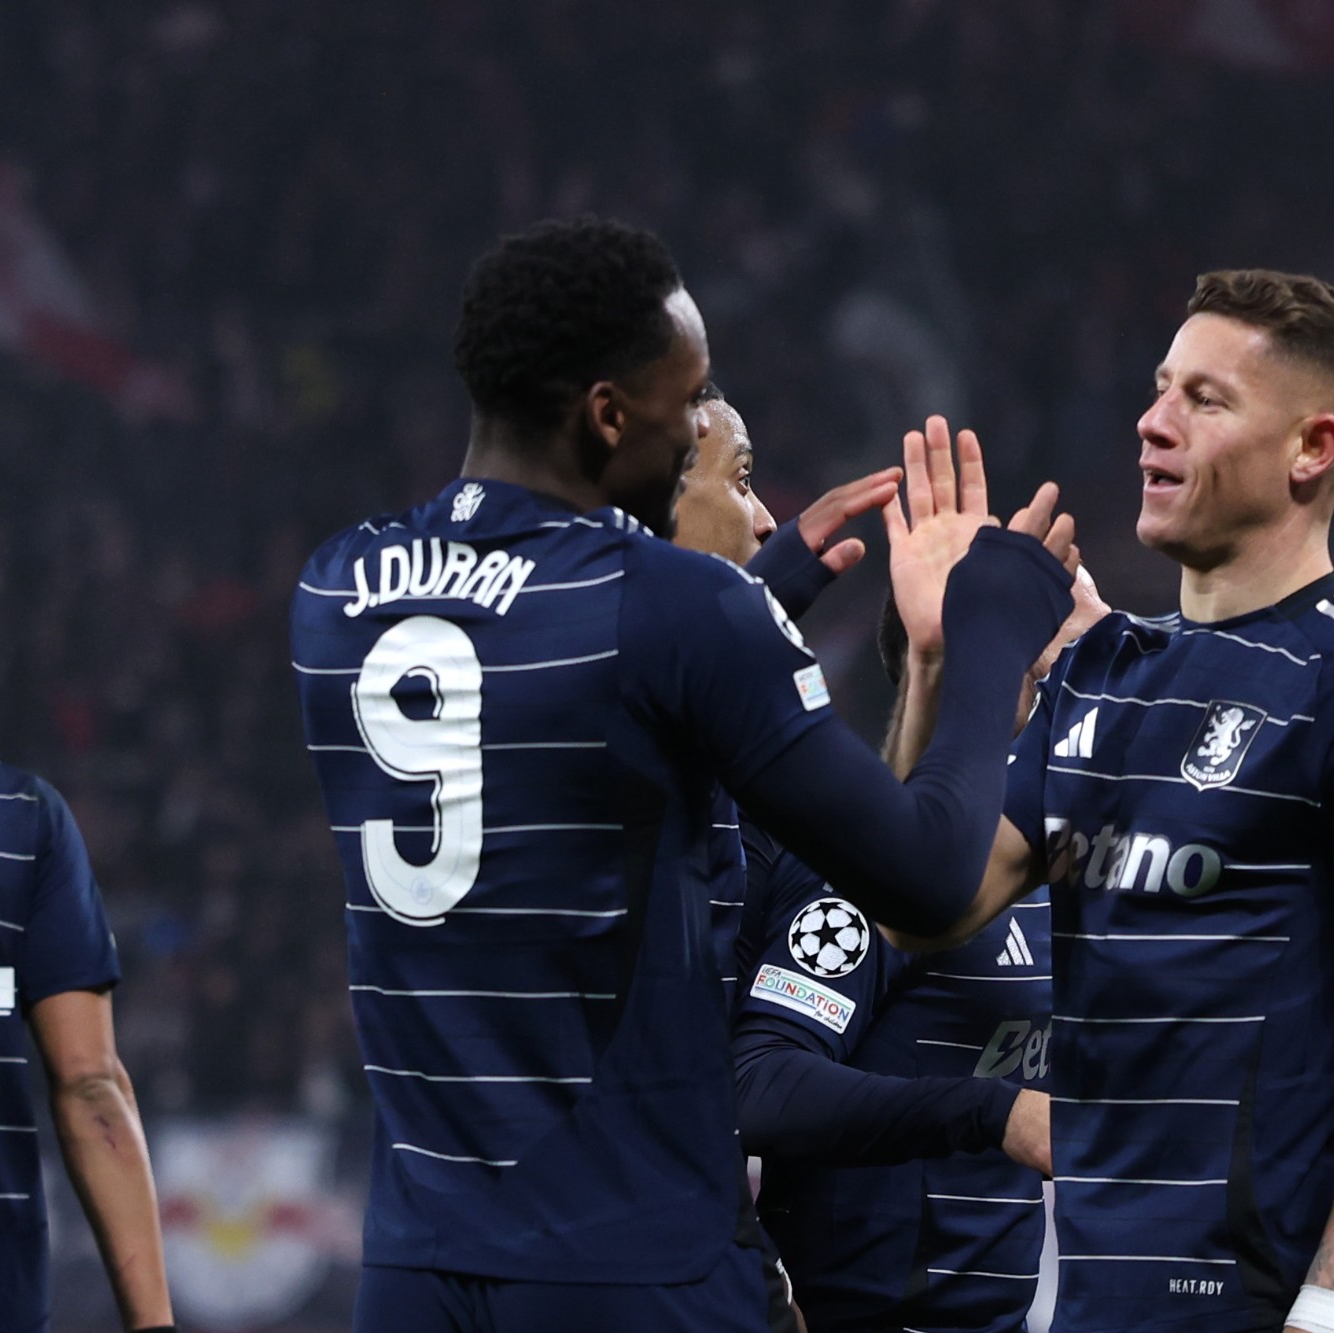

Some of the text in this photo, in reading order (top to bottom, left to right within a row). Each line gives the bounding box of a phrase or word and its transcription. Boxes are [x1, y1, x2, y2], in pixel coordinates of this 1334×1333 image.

[343, 537, 535, 618] J.DURAN
[351, 615, 483, 927] 9
[757, 975, 850, 1022] FOUNDATION
[1169, 1278, 1224, 1296] HEAT.RDY
